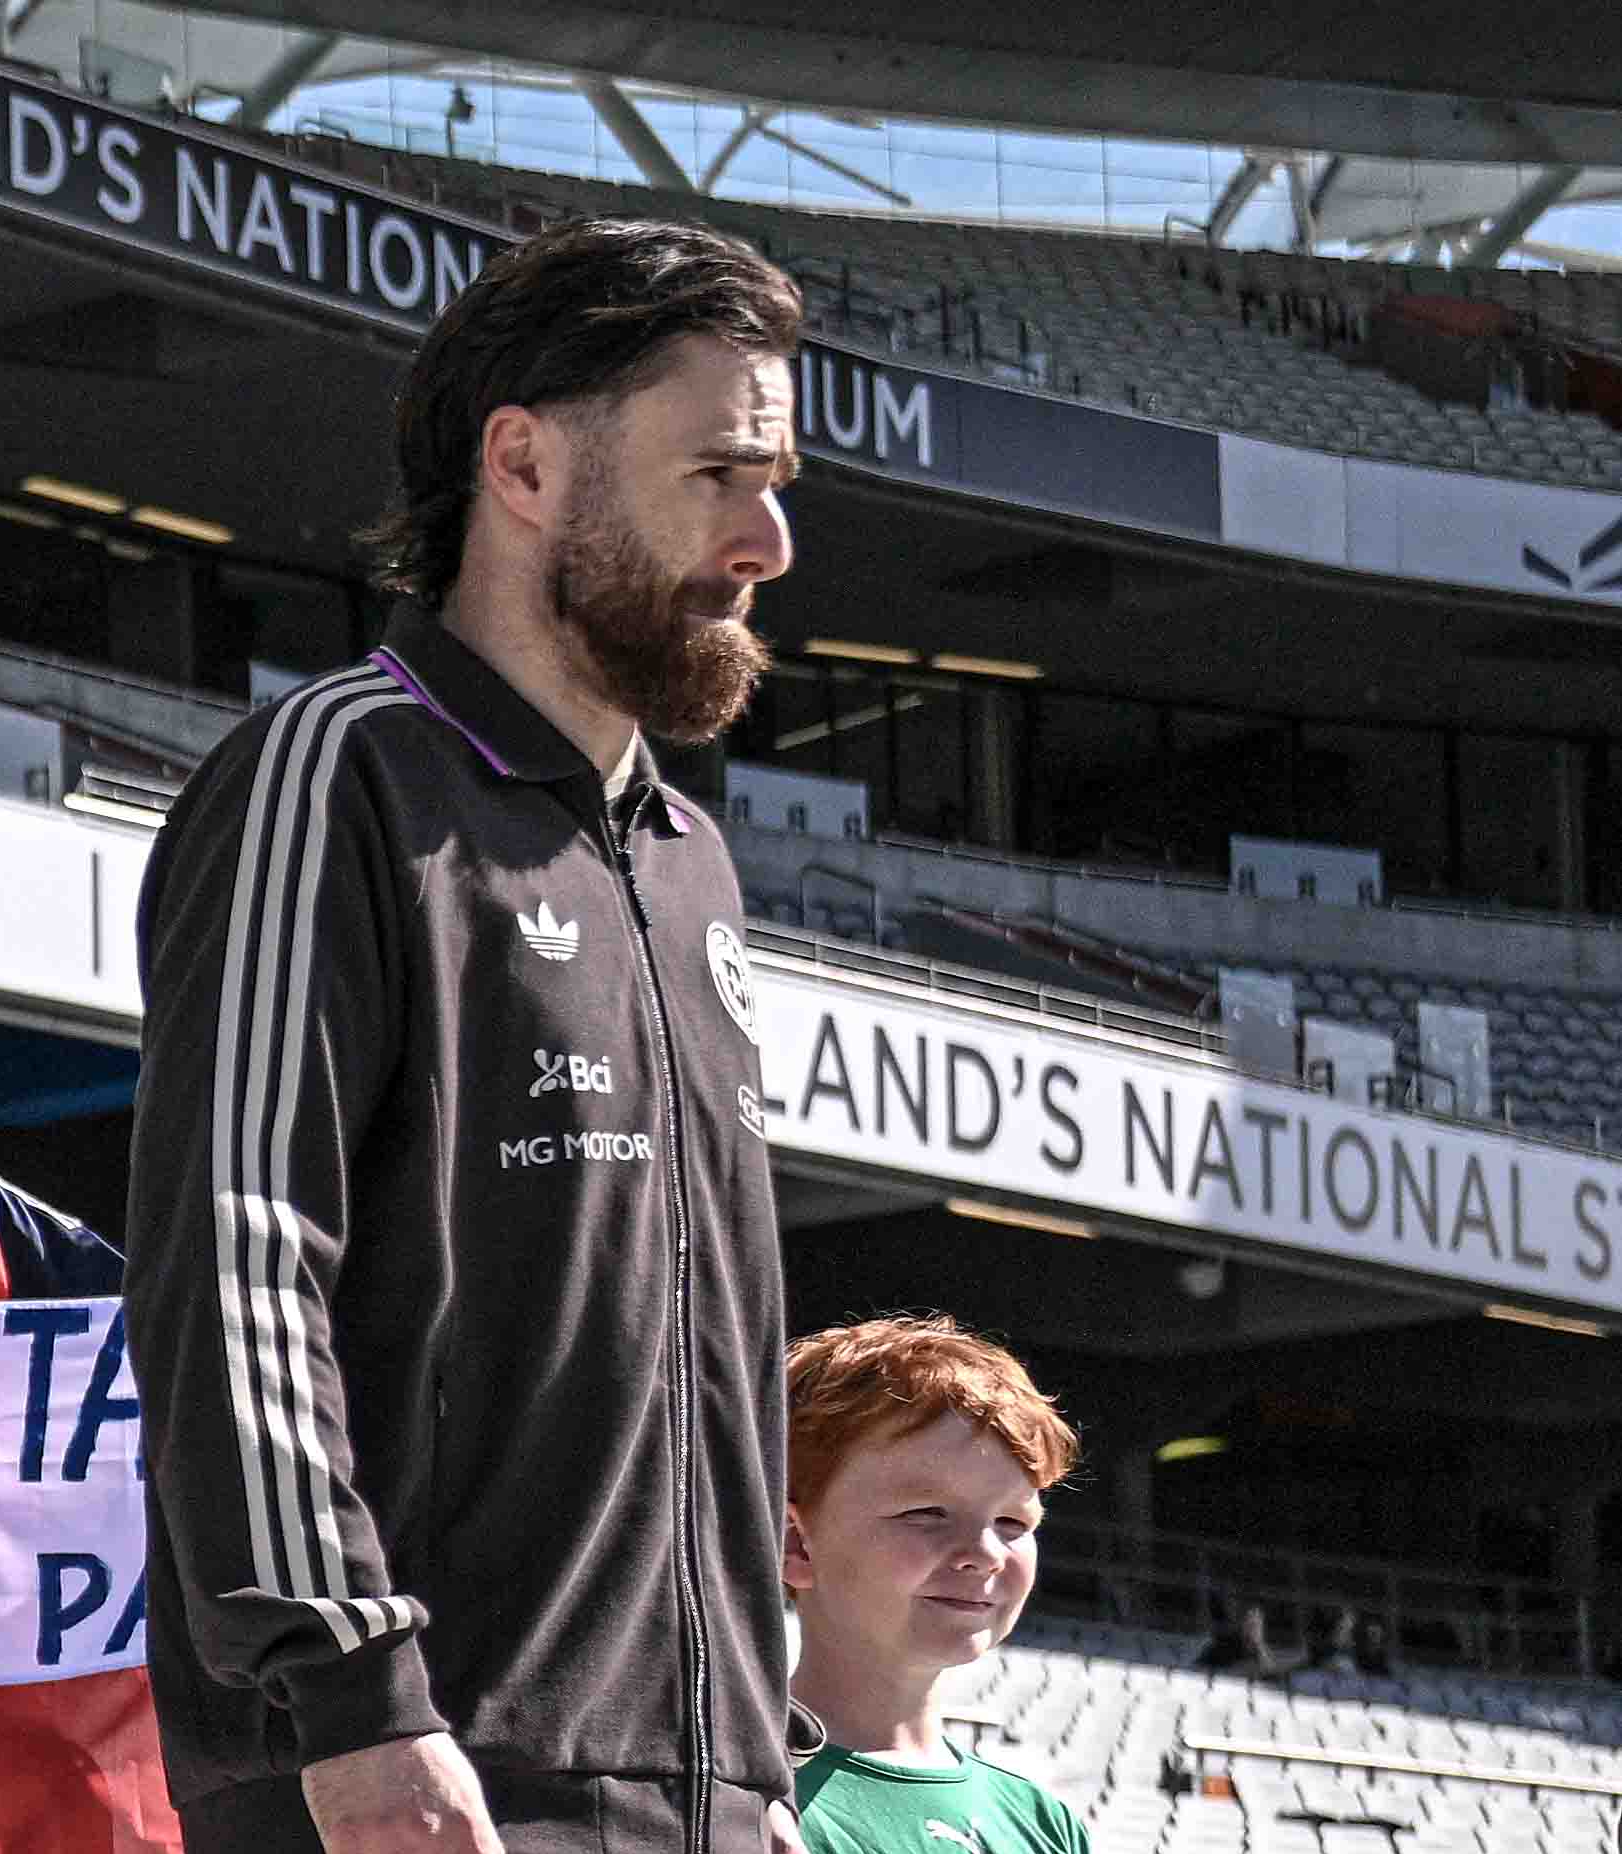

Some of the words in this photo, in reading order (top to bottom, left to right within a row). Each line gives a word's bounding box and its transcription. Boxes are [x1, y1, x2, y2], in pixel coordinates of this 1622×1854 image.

[175, 146, 483, 313] NATION
[569, 1055, 612, 1094] Bci
[499, 1137, 554, 1169] MG
[564, 1131, 653, 1162] MOTOR
[764, 1010, 1084, 1174] AND'S
[1123, 1078, 1548, 1274] NATIONAL
[1572, 1177, 1622, 1284] S
